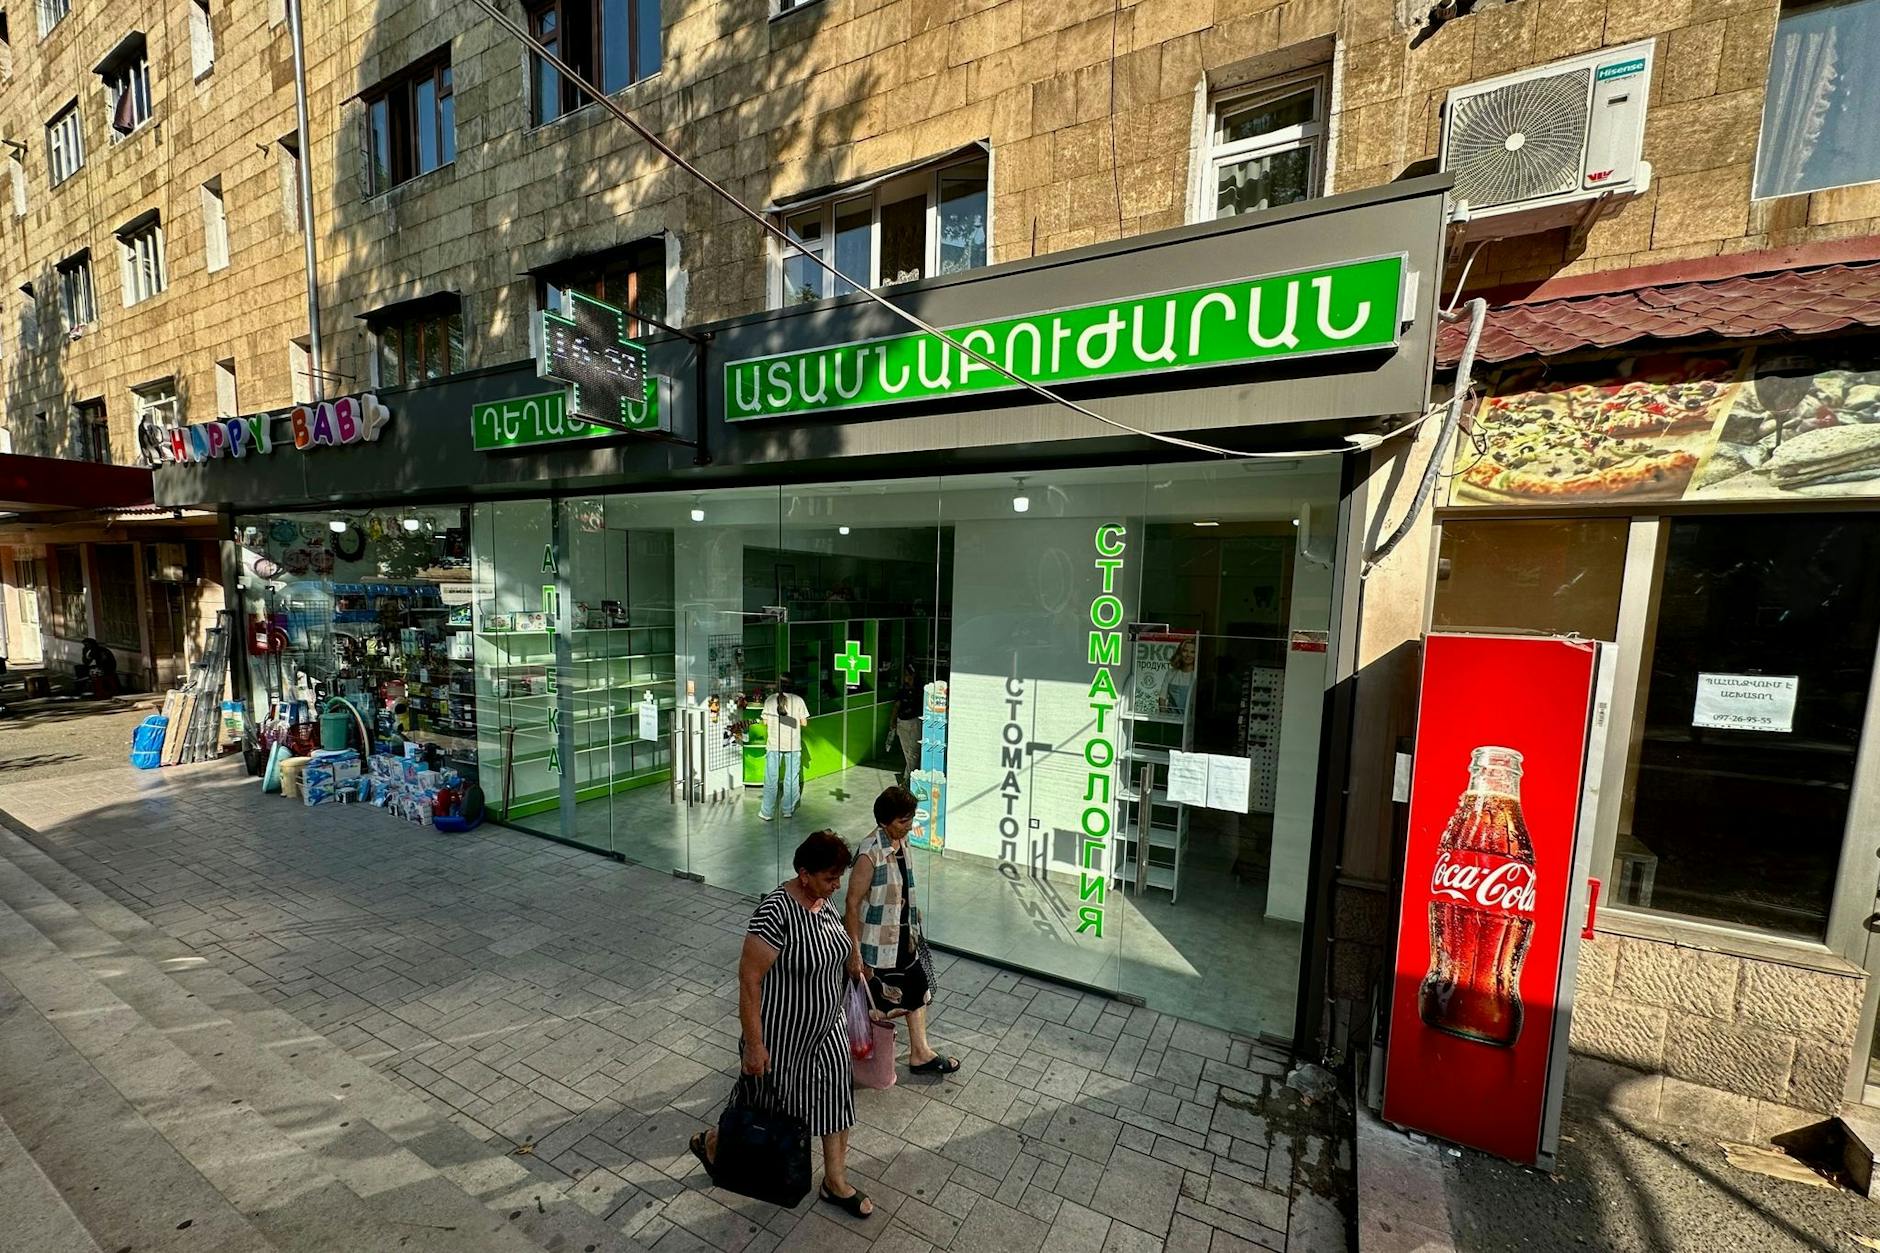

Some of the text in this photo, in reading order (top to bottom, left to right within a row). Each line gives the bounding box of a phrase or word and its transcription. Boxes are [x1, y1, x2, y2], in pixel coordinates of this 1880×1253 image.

[1599, 62, 1644, 79] Hisense
[735, 275, 1372, 412] ԱՏԱՄՆԱԲՈՒԺԱՐԱՆ
[170, 392, 390, 464] HAPPY BABY
[540, 543, 563, 775] АПТЕКА
[1720, 690, 1775, 701] ԱՇԽԱՏՈՂ
[1785, 681, 1794, 690] Է
[1075, 523, 1127, 939] СТОМАТОЛОГИЯ
[1712, 714, 1773, 724] 097-26-95-55
